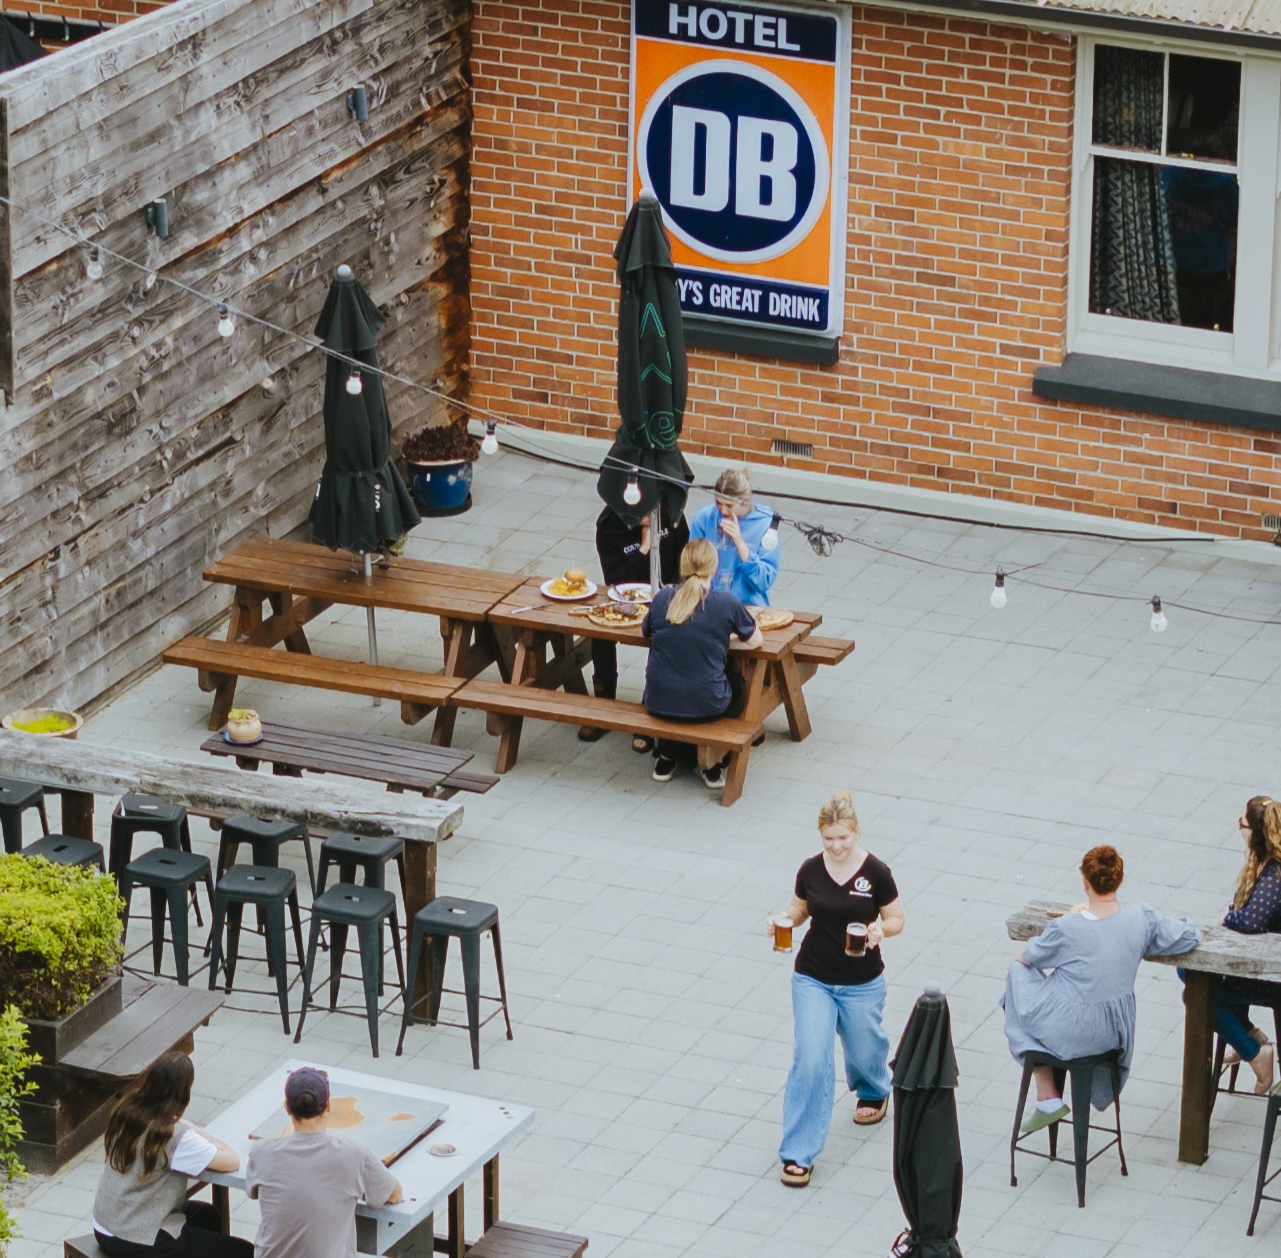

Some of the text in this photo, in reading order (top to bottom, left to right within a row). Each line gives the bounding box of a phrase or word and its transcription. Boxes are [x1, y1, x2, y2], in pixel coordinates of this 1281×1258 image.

[668, 2, 801, 52] HOTEL
[669, 104, 799, 222] DB
[674, 277, 821, 323] Y'S GREAT DRINK
